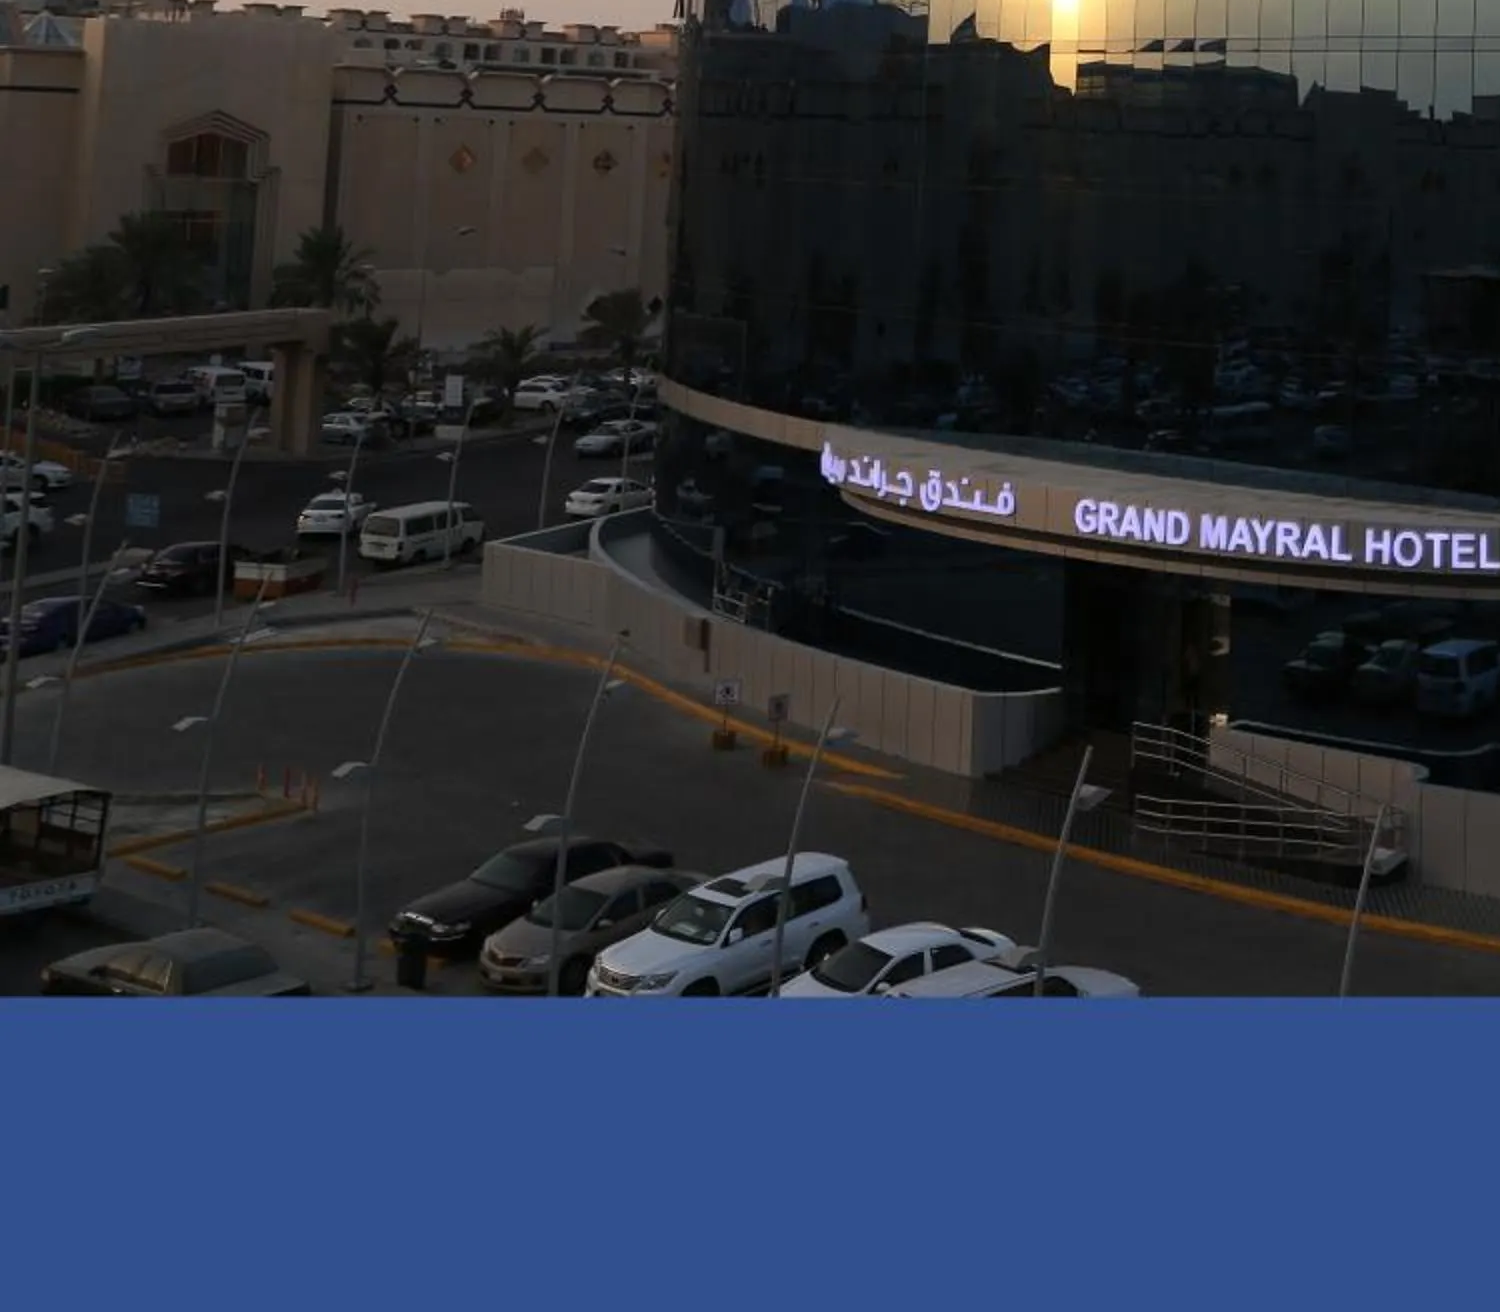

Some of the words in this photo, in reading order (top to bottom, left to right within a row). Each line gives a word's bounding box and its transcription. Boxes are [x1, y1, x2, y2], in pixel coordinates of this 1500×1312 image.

[919, 467, 1015, 517] فندق
[1074, 498, 1190, 545] GRAND
[1199, 514, 1353, 561] MAYRAL
